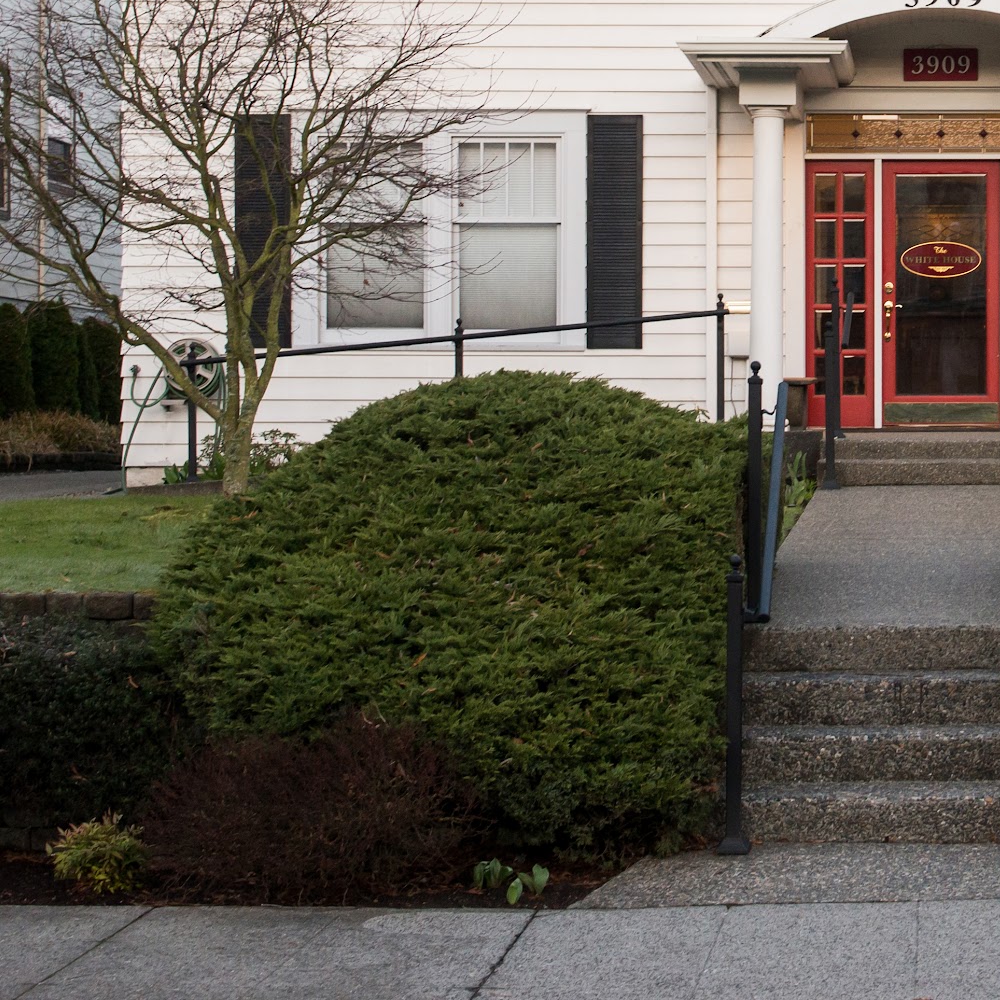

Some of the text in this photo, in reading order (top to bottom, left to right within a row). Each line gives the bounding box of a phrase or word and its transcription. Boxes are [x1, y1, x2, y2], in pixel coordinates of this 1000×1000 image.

[911, 55, 971, 75] 3909
[933, 246, 948, 254] The
[905, 256, 977, 264] WHITE HOUSE
